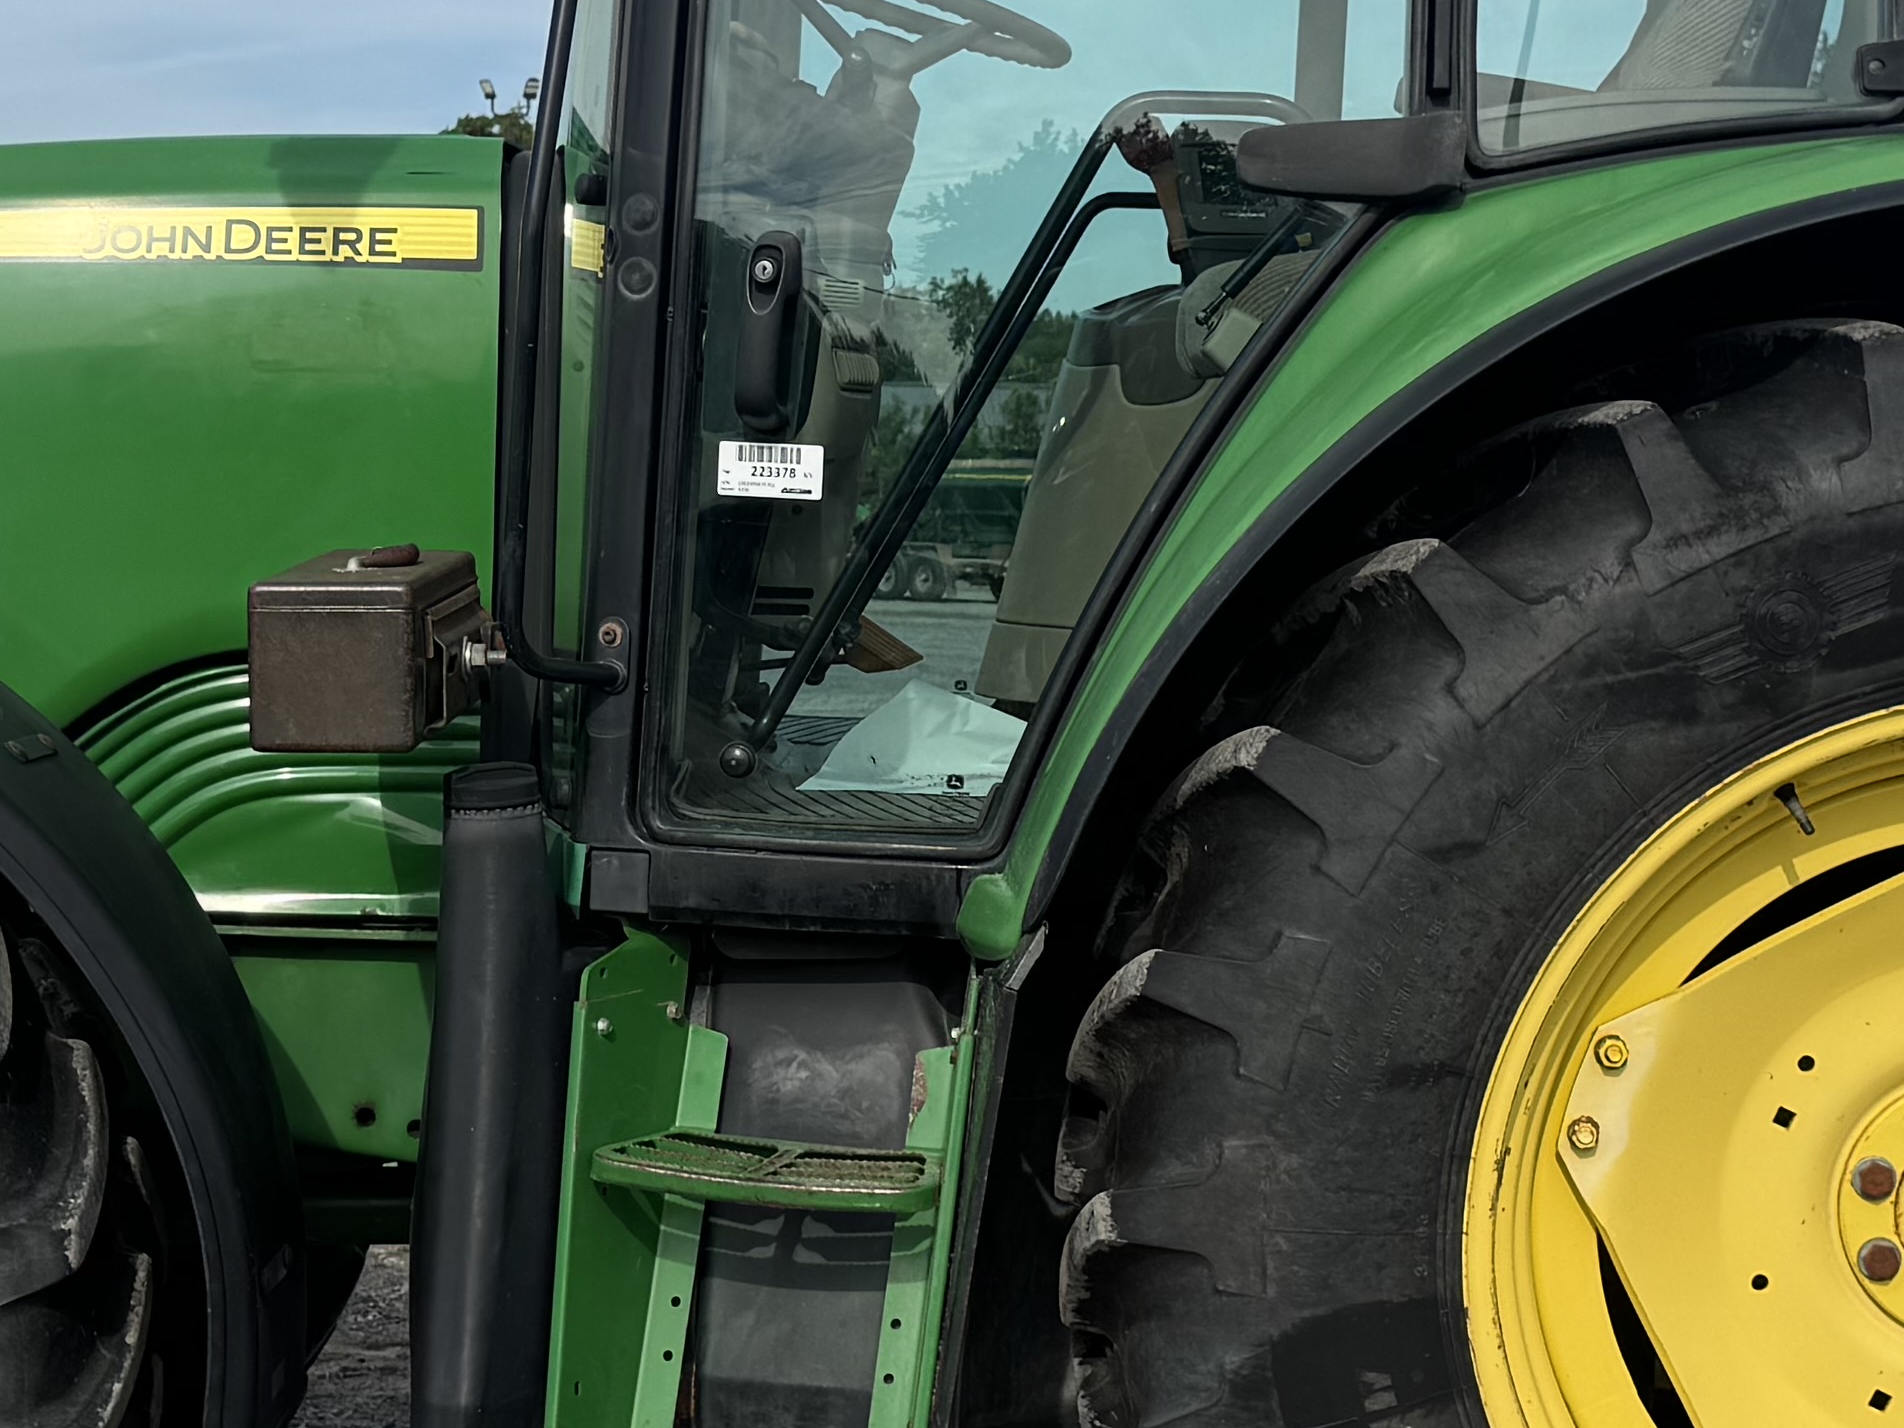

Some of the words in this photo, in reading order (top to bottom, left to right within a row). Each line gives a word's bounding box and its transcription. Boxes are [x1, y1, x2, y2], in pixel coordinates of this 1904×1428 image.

[83, 220, 212, 254] JOHN
[224, 218, 398, 257] DEERE
[751, 465, 797, 478] 223378
